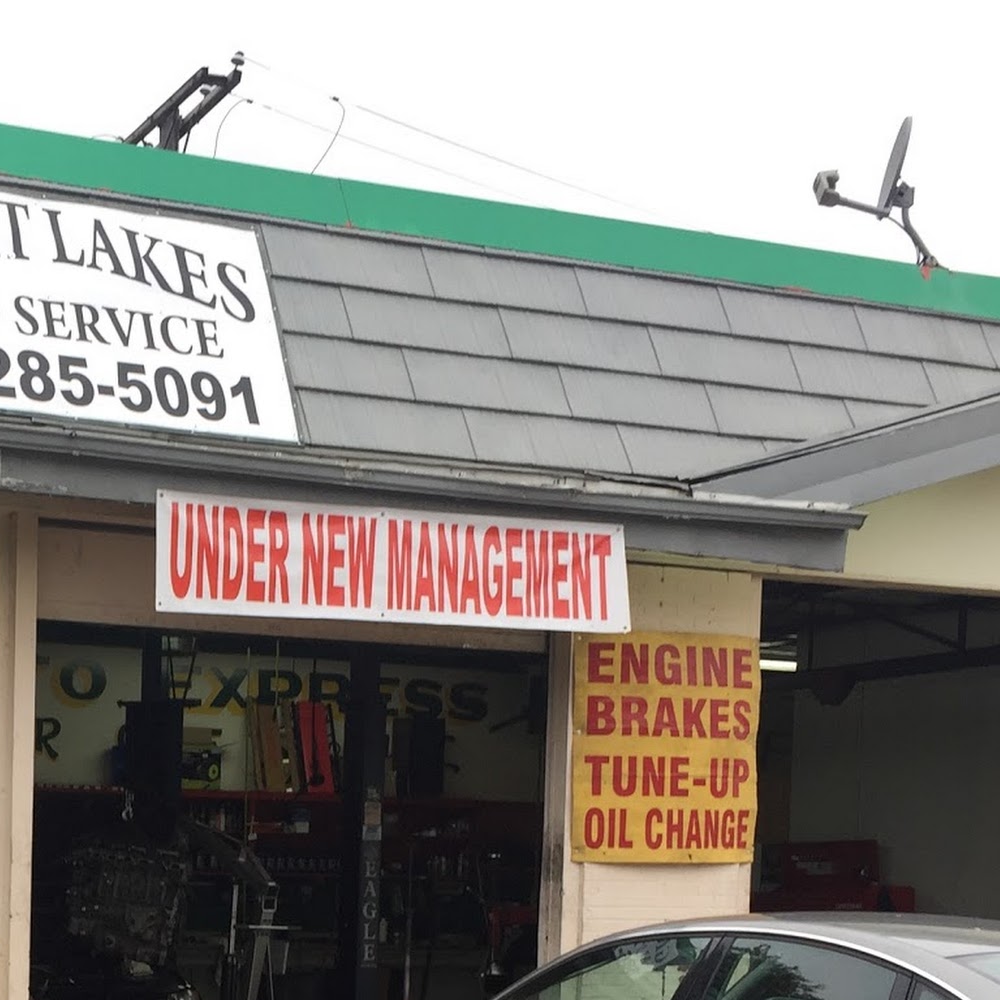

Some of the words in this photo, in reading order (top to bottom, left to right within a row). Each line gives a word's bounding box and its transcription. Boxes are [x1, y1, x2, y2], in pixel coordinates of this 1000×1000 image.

[43, 208, 257, 322] LAKES
[13, 296, 225, 358] SERVICE
[169, 502, 290, 604] UNDER
[301, 513, 377, 608] NEW
[387, 519, 612, 620] MANAGEMENT
[587, 642, 753, 689] ENGINE
[586, 695, 751, 740] BRAKES
[584, 755, 750, 799] TUNE-UP
[584, 807, 633, 849] OIL
[644, 807, 750, 850] CHANGE
[362, 861, 377, 961] EAGLE
